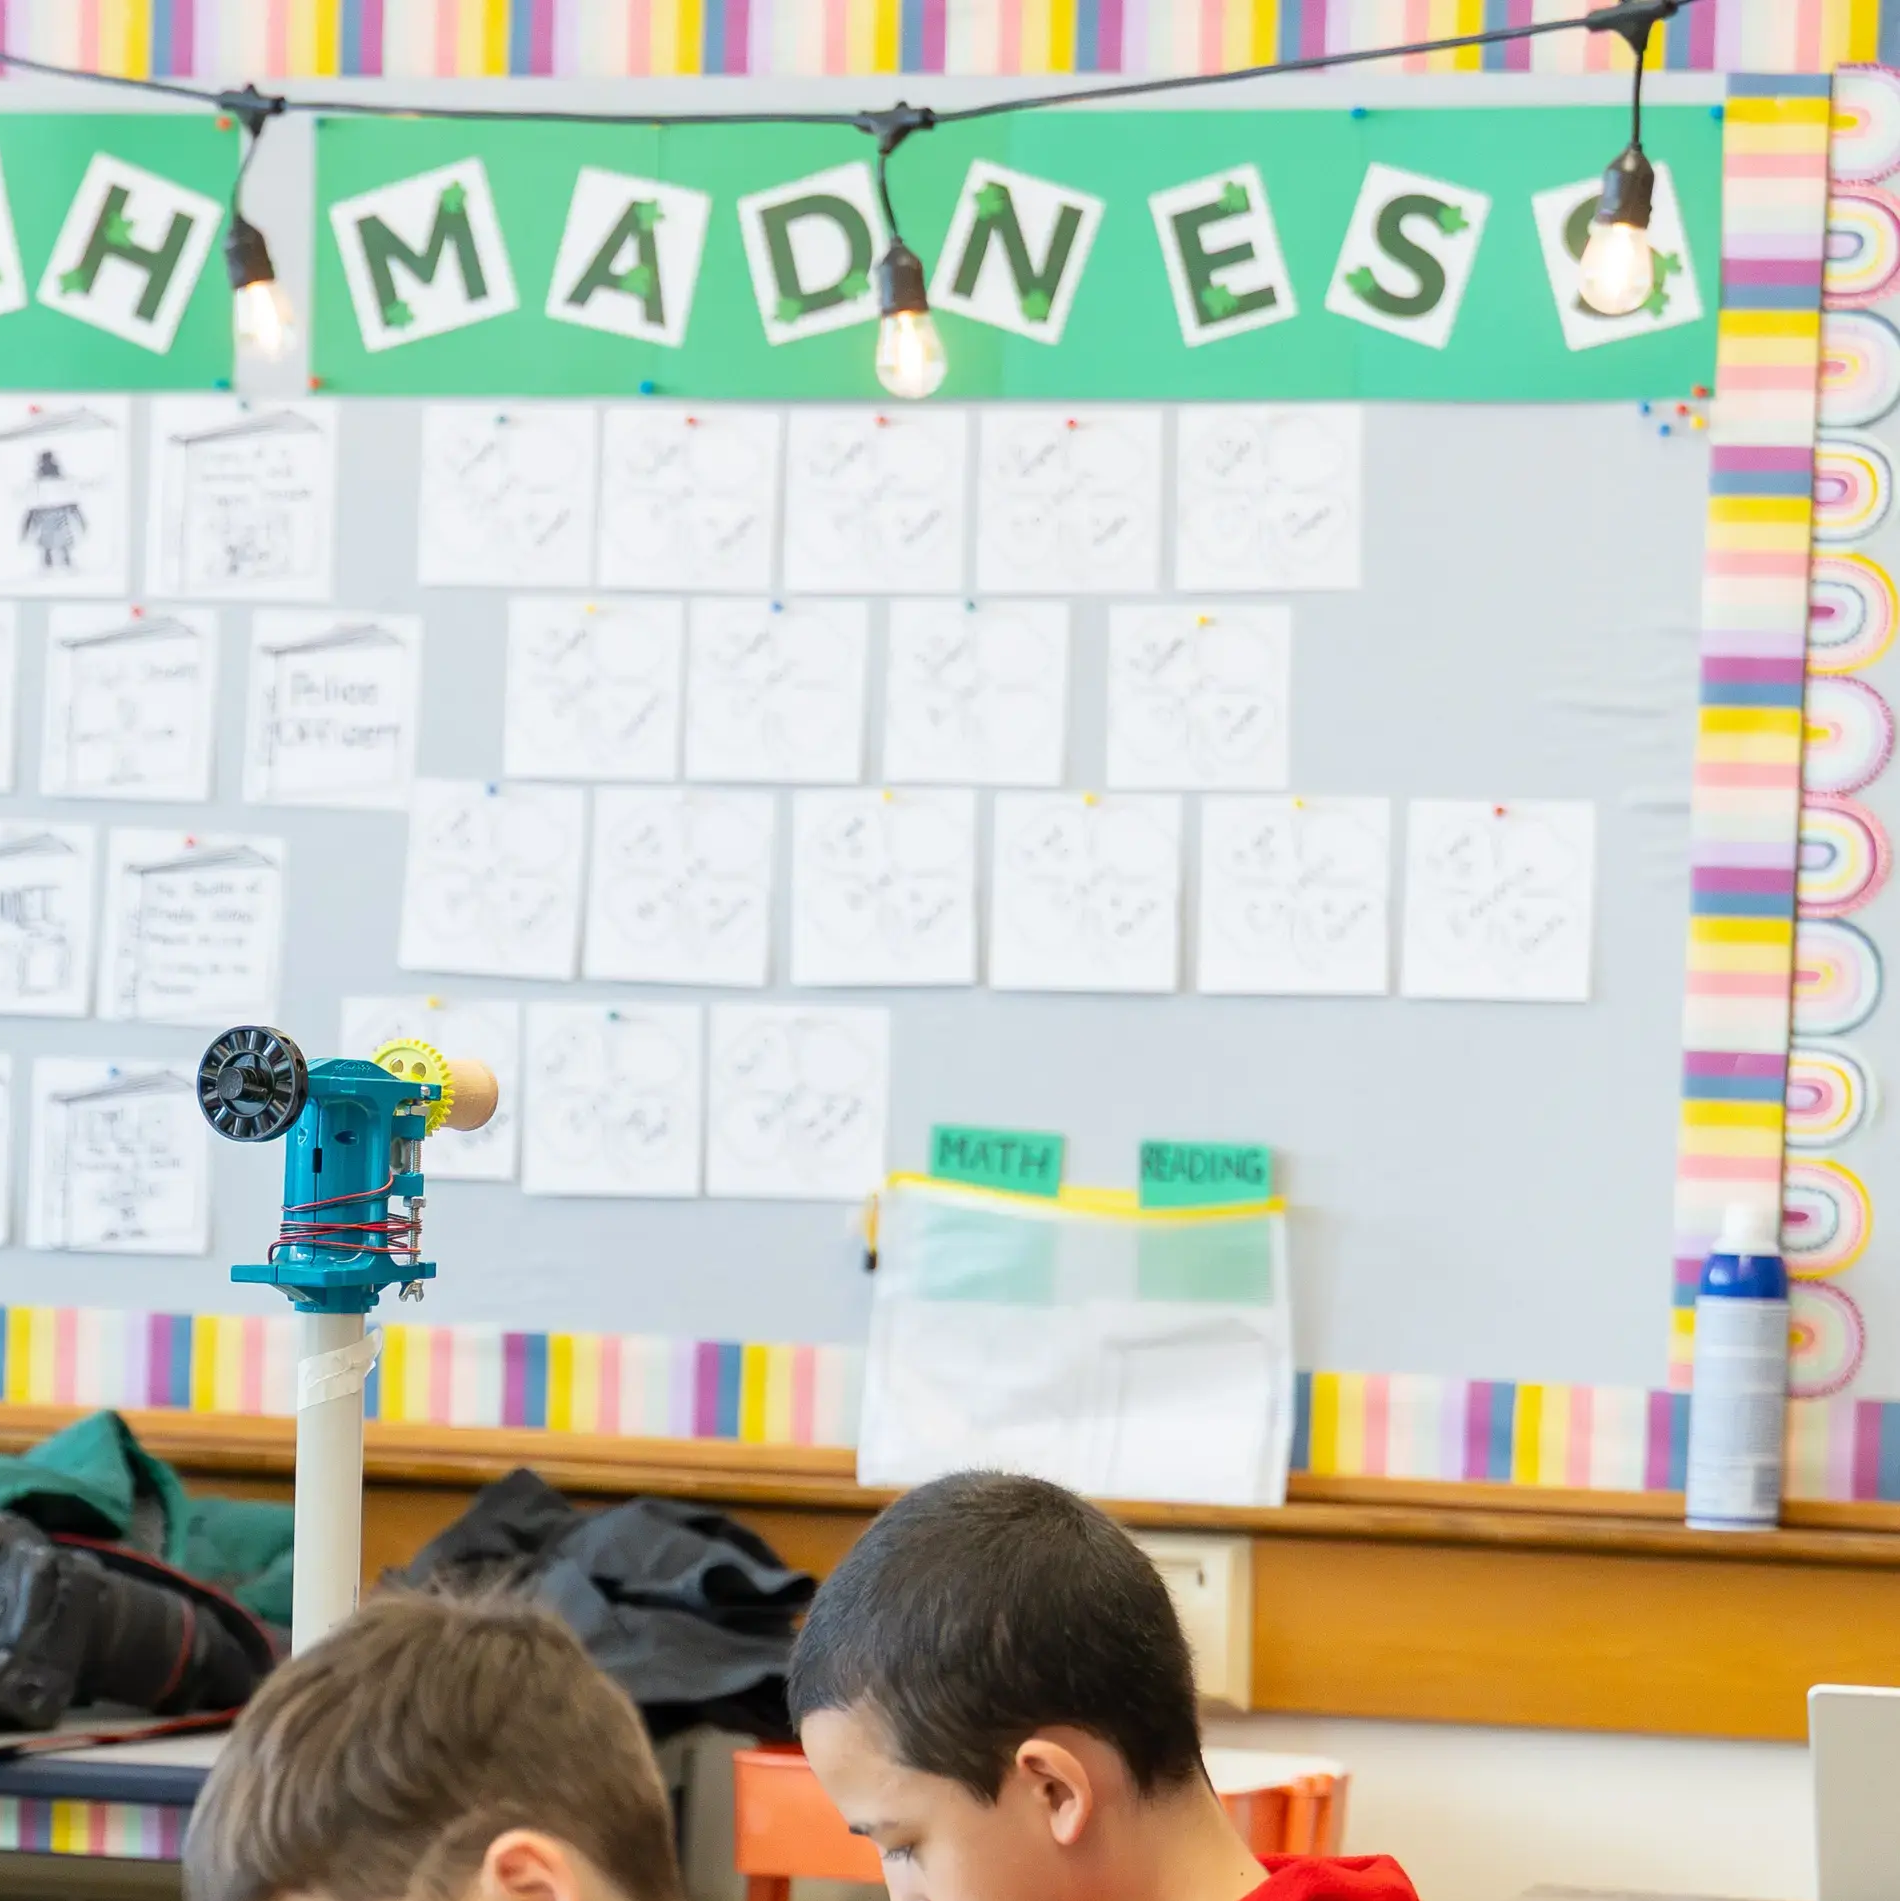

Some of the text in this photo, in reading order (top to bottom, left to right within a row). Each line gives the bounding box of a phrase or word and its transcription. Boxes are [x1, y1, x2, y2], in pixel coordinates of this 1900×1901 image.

[353, 172, 1672, 326] MADNES
[936, 1134, 1052, 1180] MATH
[1140, 1143, 1266, 1186] READING
